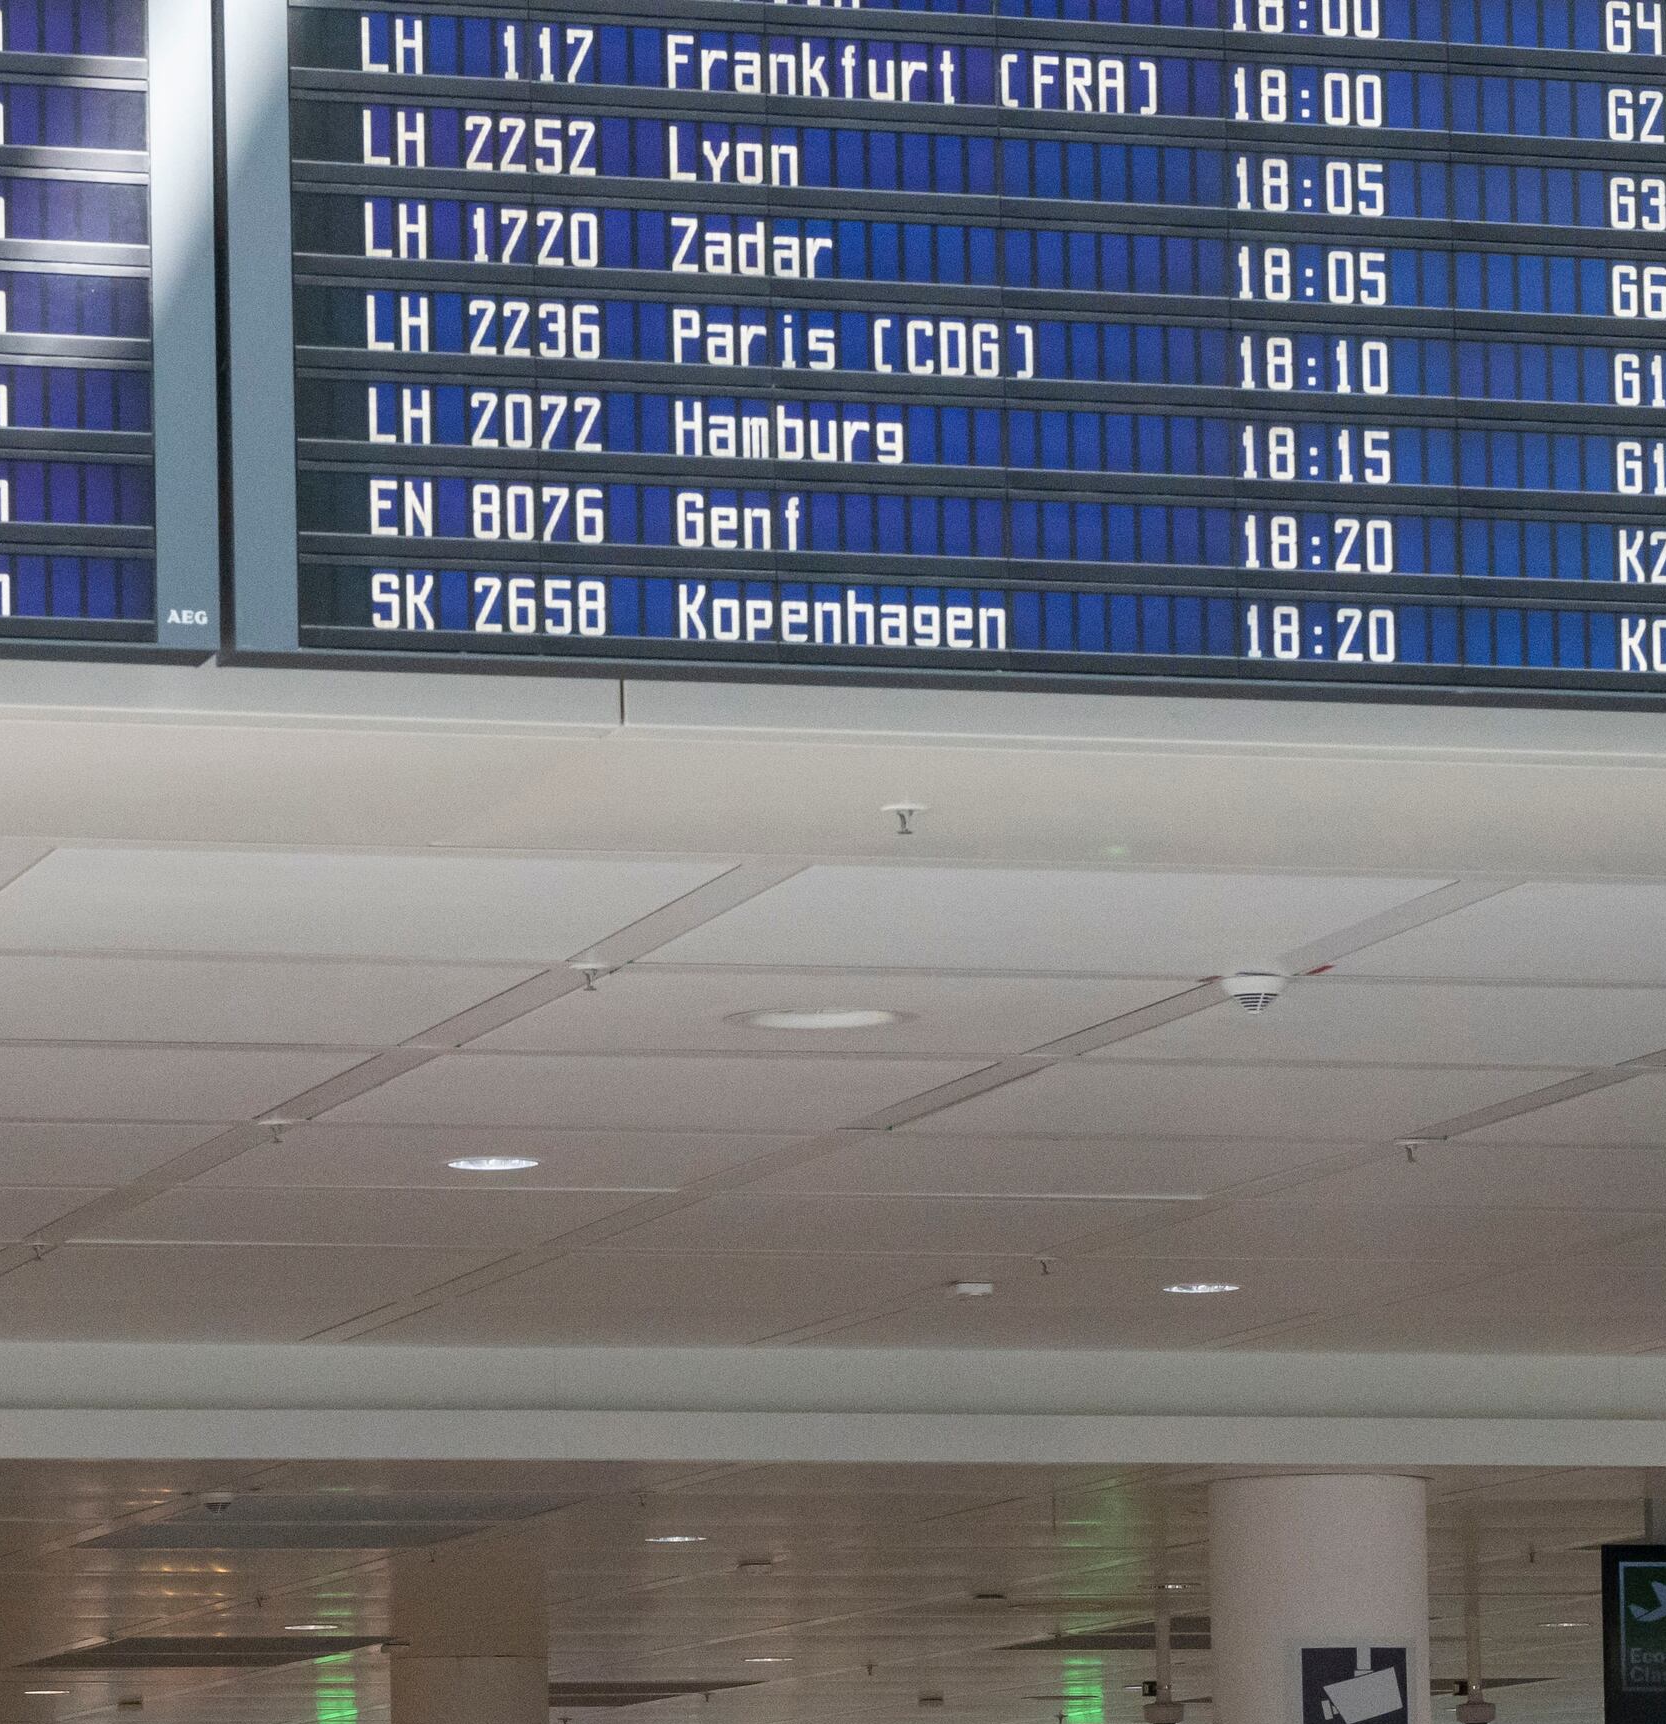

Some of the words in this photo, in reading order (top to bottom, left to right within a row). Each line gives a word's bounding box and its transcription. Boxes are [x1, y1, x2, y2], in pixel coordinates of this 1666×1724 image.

[361, 18, 423, 76] LH
[504, 26, 592, 85] 117
[668, 34, 955, 105] Frankfurt
[1233, 66, 1382, 129] 18:00
[367, 294, 429, 353] LH
[468, 299, 600, 361] 2236
[673, 308, 835, 372] Paris
[1240, 335, 1388, 396] 18:10
[370, 478, 432, 539] EN
[471, 485, 604, 545] 8076
[677, 492, 799, 552] Genf
[1244, 514, 1393, 574] 18:20
[167, 609, 208, 625] AEG
